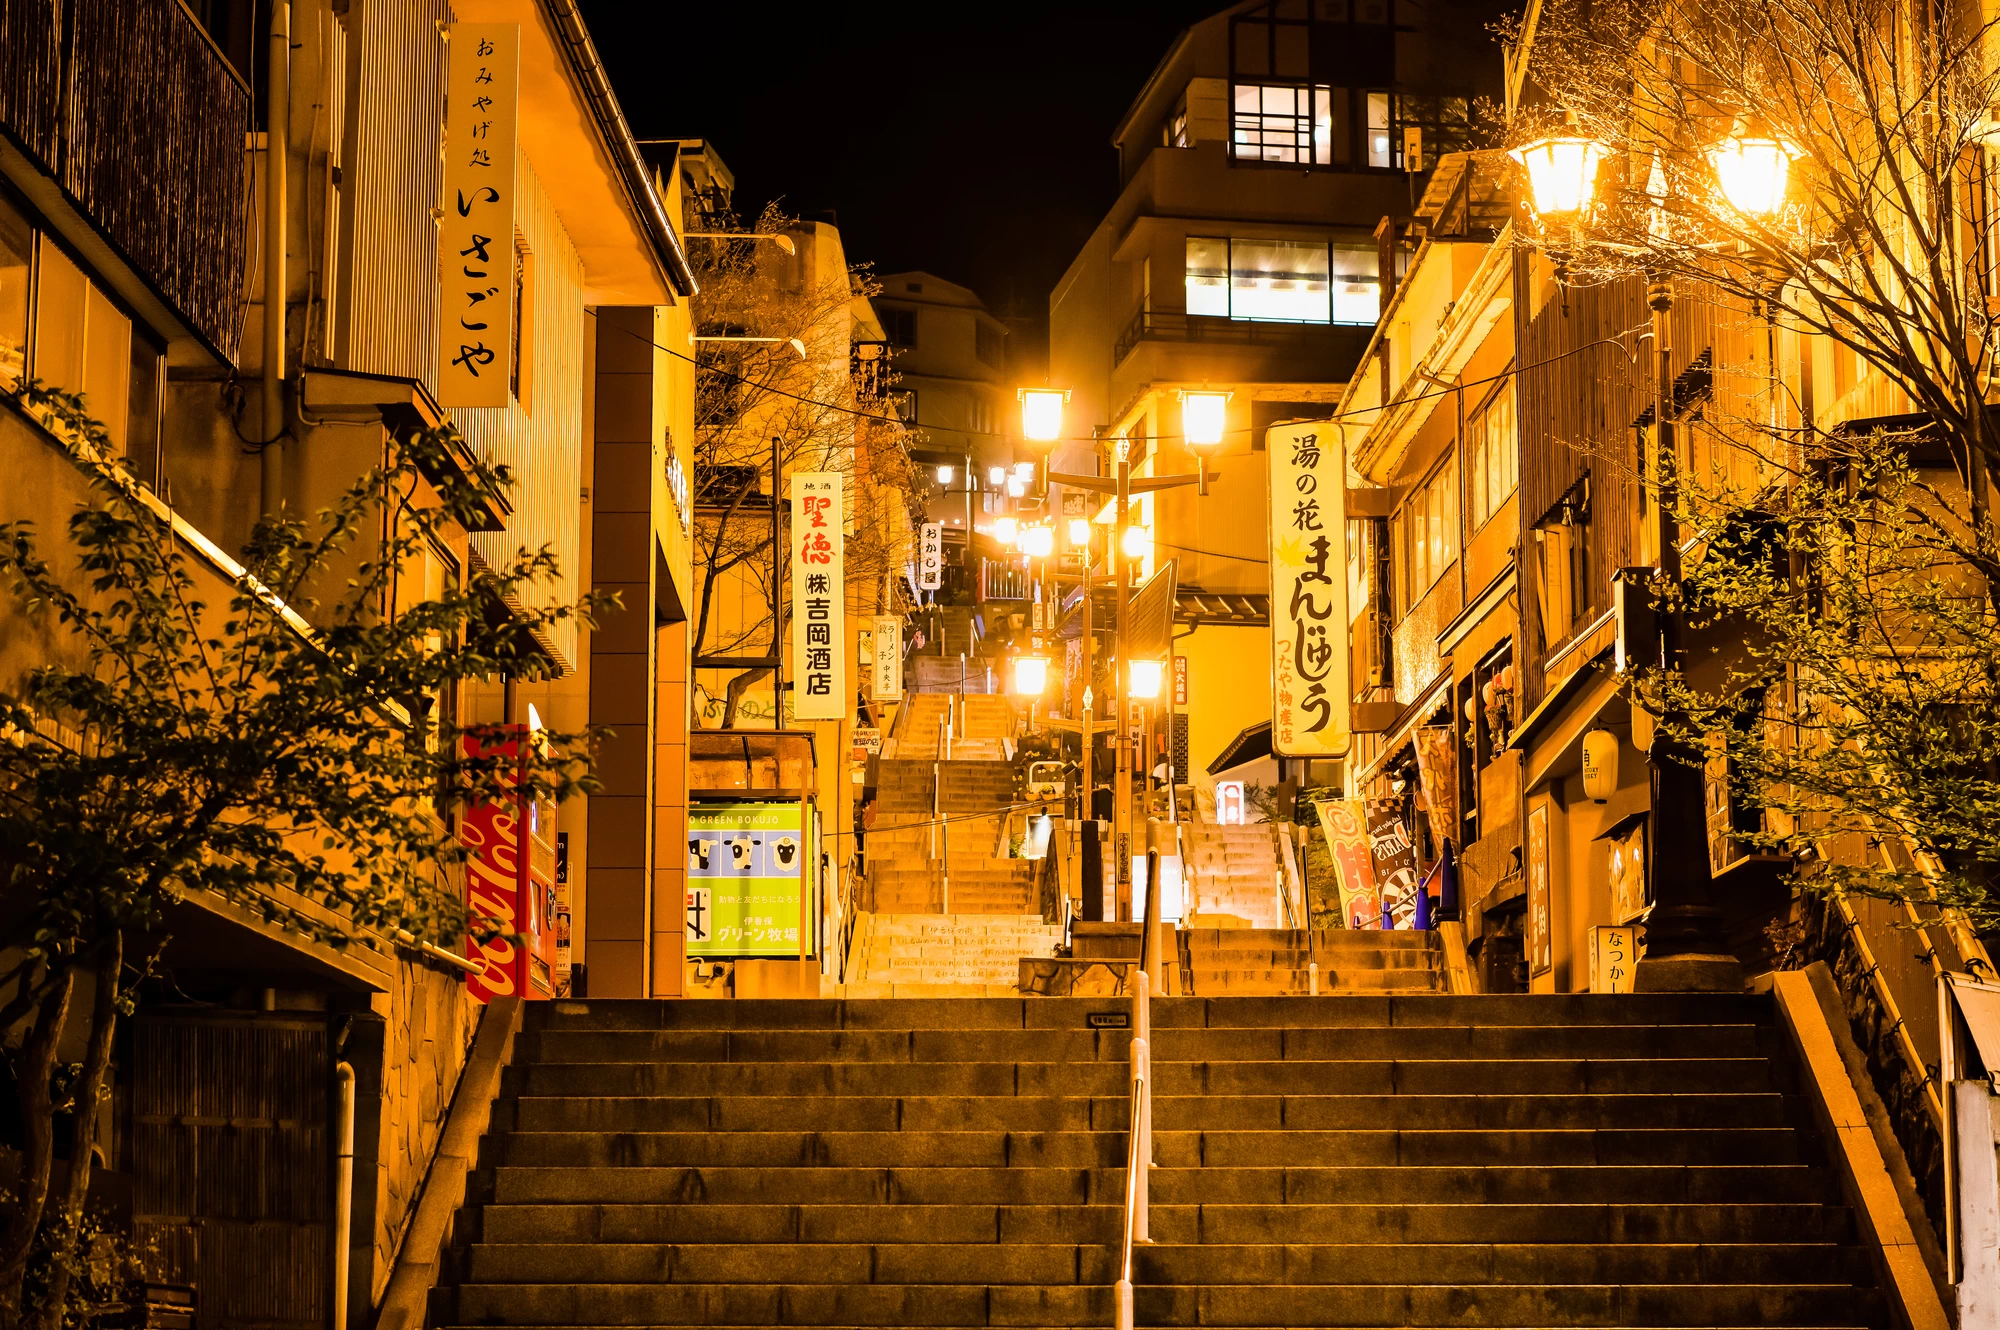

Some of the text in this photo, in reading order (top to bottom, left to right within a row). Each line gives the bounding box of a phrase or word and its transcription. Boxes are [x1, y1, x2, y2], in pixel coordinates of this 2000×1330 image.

[469, 37, 494, 167] おみやげ処
[452, 186, 500, 378] いさごや
[803, 482, 831, 490] 地酒
[801, 495, 836, 565] 聖徳
[924, 528, 937, 584] おかし屋
[887, 625, 895, 661] ラーメン
[883, 664, 891, 691] 中央亭
[1276, 639, 1293, 745] つたや物産店
[700, 816, 733, 824] GREEN
[718, 925, 799, 942] グリーン牧場
[743, 916, 773, 926] 伊香保
